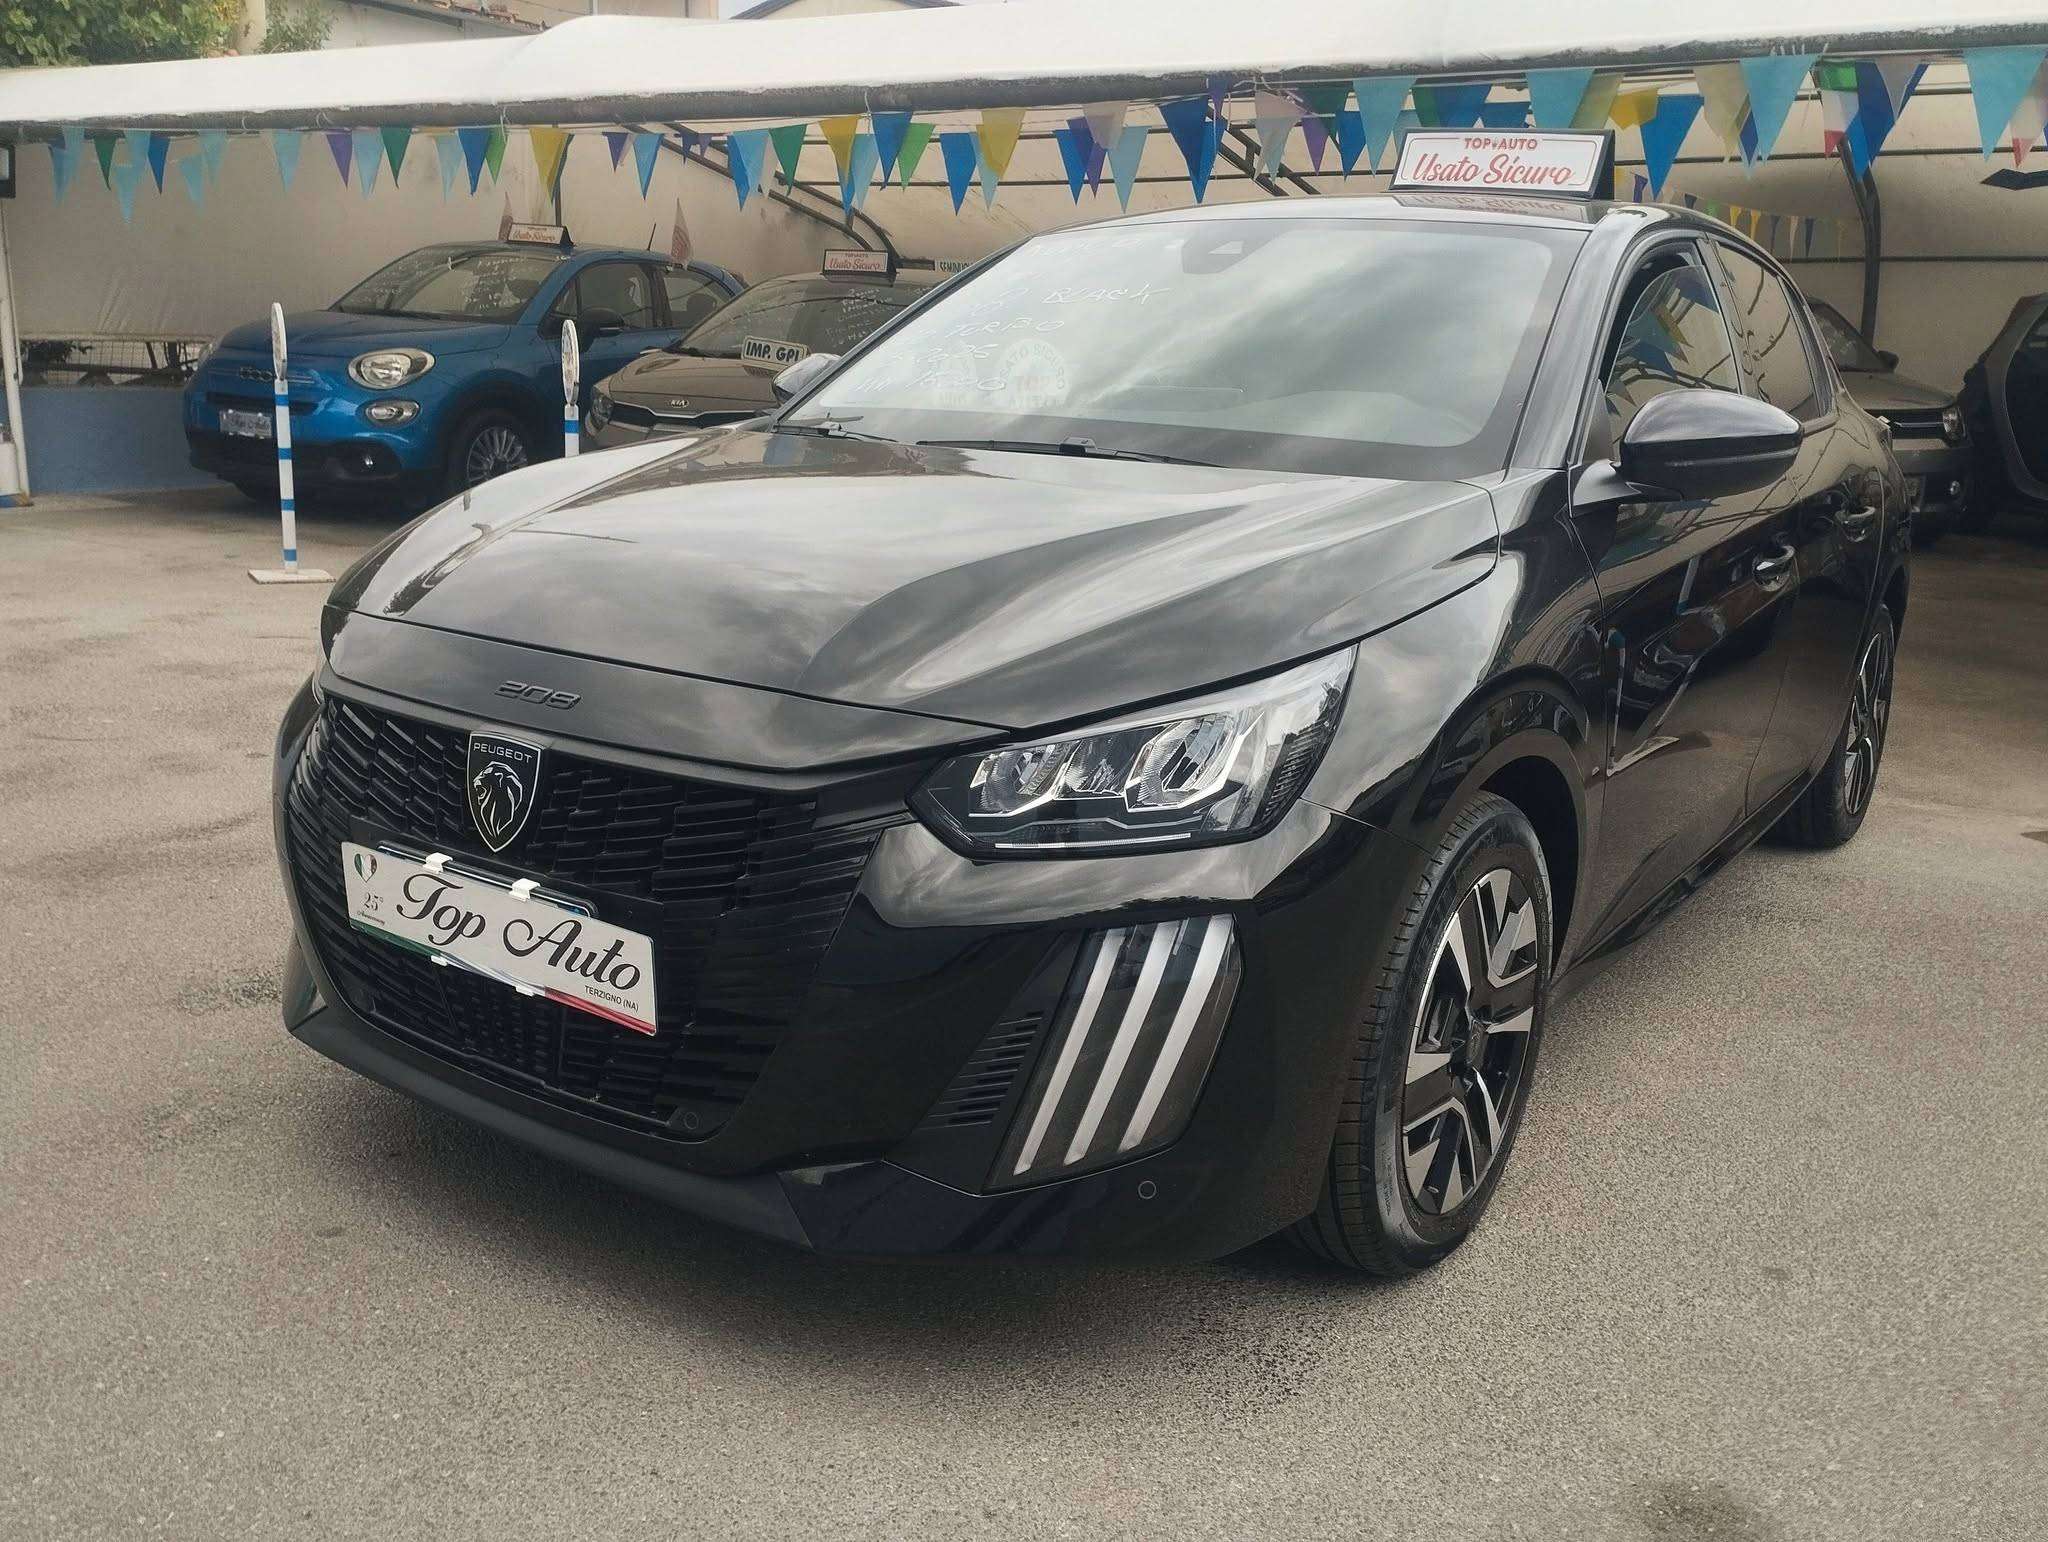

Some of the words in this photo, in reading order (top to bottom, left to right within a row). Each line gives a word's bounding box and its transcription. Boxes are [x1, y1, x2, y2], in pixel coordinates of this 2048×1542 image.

[1464, 137, 1496, 150] TOP
[1499, 138, 1538, 150] AUTO
[1412, 152, 1482, 182] Usato
[1483, 153, 1573, 185] Sicuro
[745, 341, 771, 359] IMP.
[494, 680, 582, 710] 208
[472, 742, 533, 764] PEUGEOT
[396, 873, 486, 946] Top
[502, 918, 641, 990] Auto
[584, 985, 622, 1007] TERZIGNO
[622, 1000, 639, 1013] (NA)
